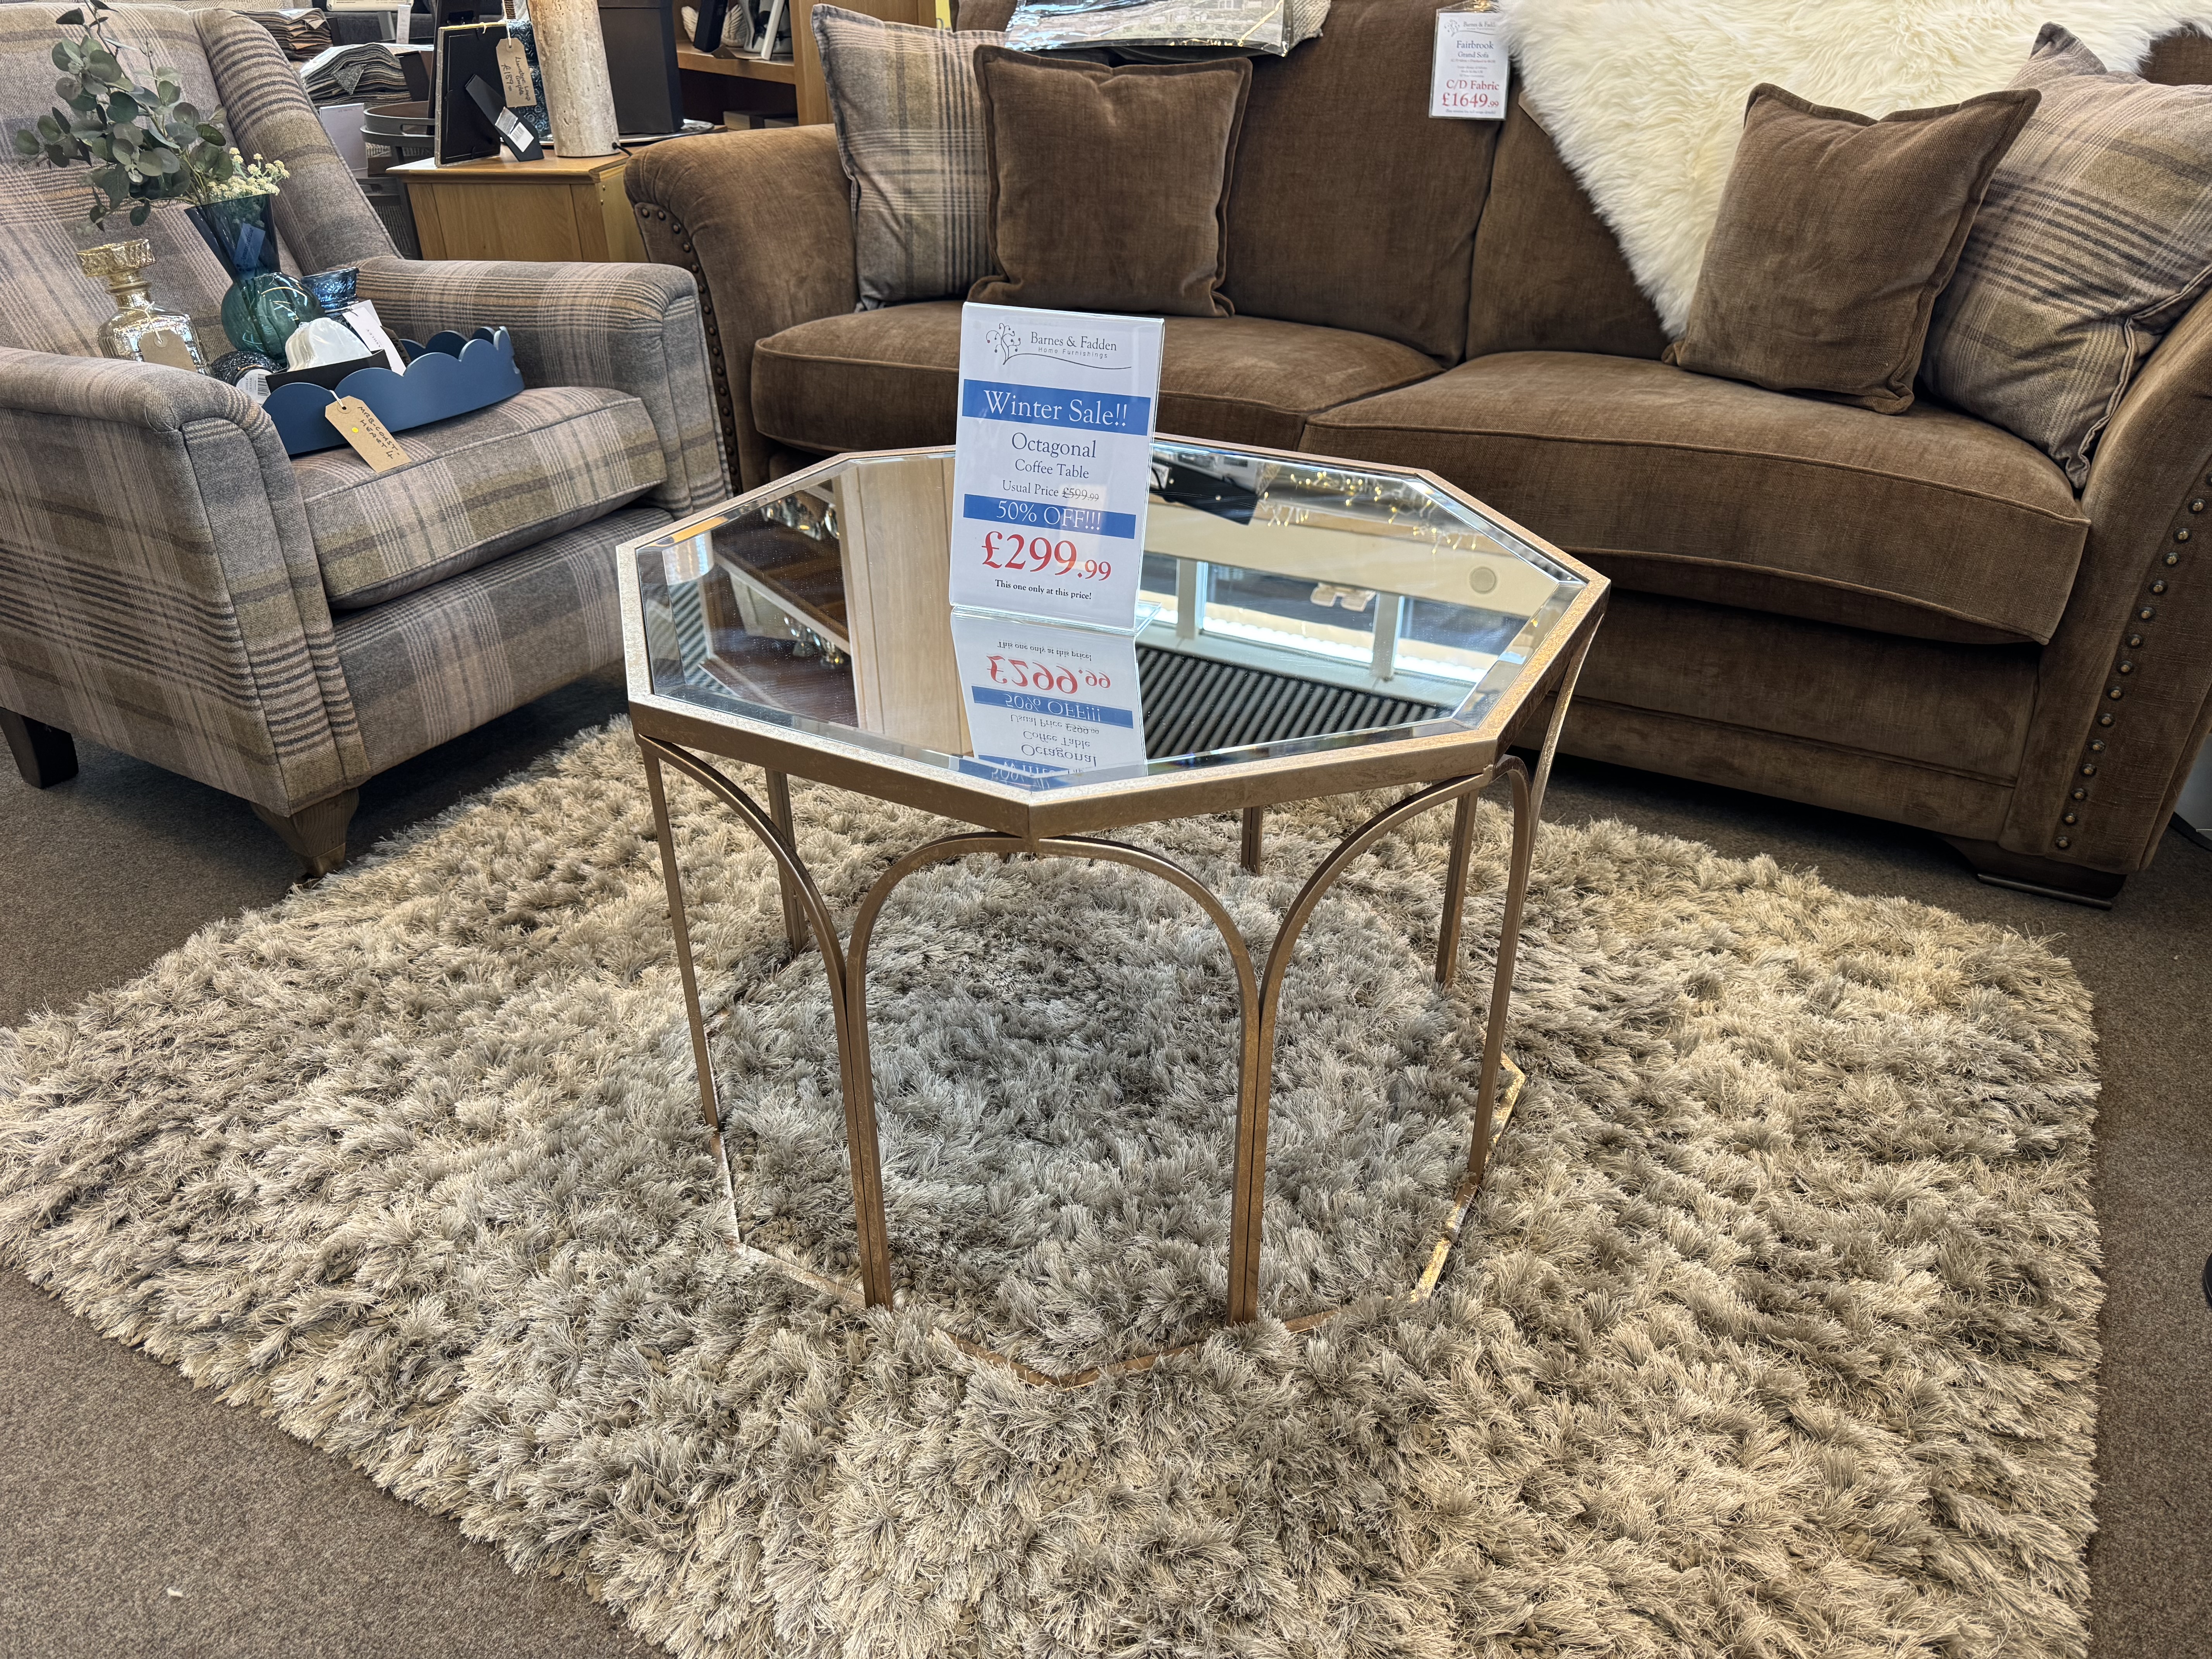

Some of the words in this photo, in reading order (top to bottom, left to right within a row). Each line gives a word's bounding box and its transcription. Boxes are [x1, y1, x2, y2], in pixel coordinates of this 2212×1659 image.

[1457, 40, 1494, 49] Fairbrook
[1446, 80, 1467, 89] C/D
[1471, 81, 1499, 90] Fabric
[1442, 93, 1499, 107] £1649.99
[1031, 331, 1063, 347] Barnes
[1066, 337, 1076, 348] &
[1080, 336, 1117, 351] Fadden
[1063, 349, 1108, 359] Furnishings
[984, 390, 1062, 421] Winter
[1069, 399, 1127, 427] Sale!!
[360, 420, 387, 448] HEART
[1012, 433, 1096, 458] Octagonal
[1015, 459, 1053, 474] Coffee
[1057, 463, 1089, 478] Table
[1003, 480, 1030, 494] Usual
[1034, 484, 1058, 497] Price
[1062, 487, 1099, 501] £599.99
[996, 500, 1037, 522] 50%
[1044, 507, 1101, 531] OFF!!!
[981, 531, 1111, 581] £299.99
[995, 579, 1011, 589] This
[1028, 585, 1044, 594] only
[1056, 588, 1068, 597] this
[1071, 592, 1091, 600] price!
